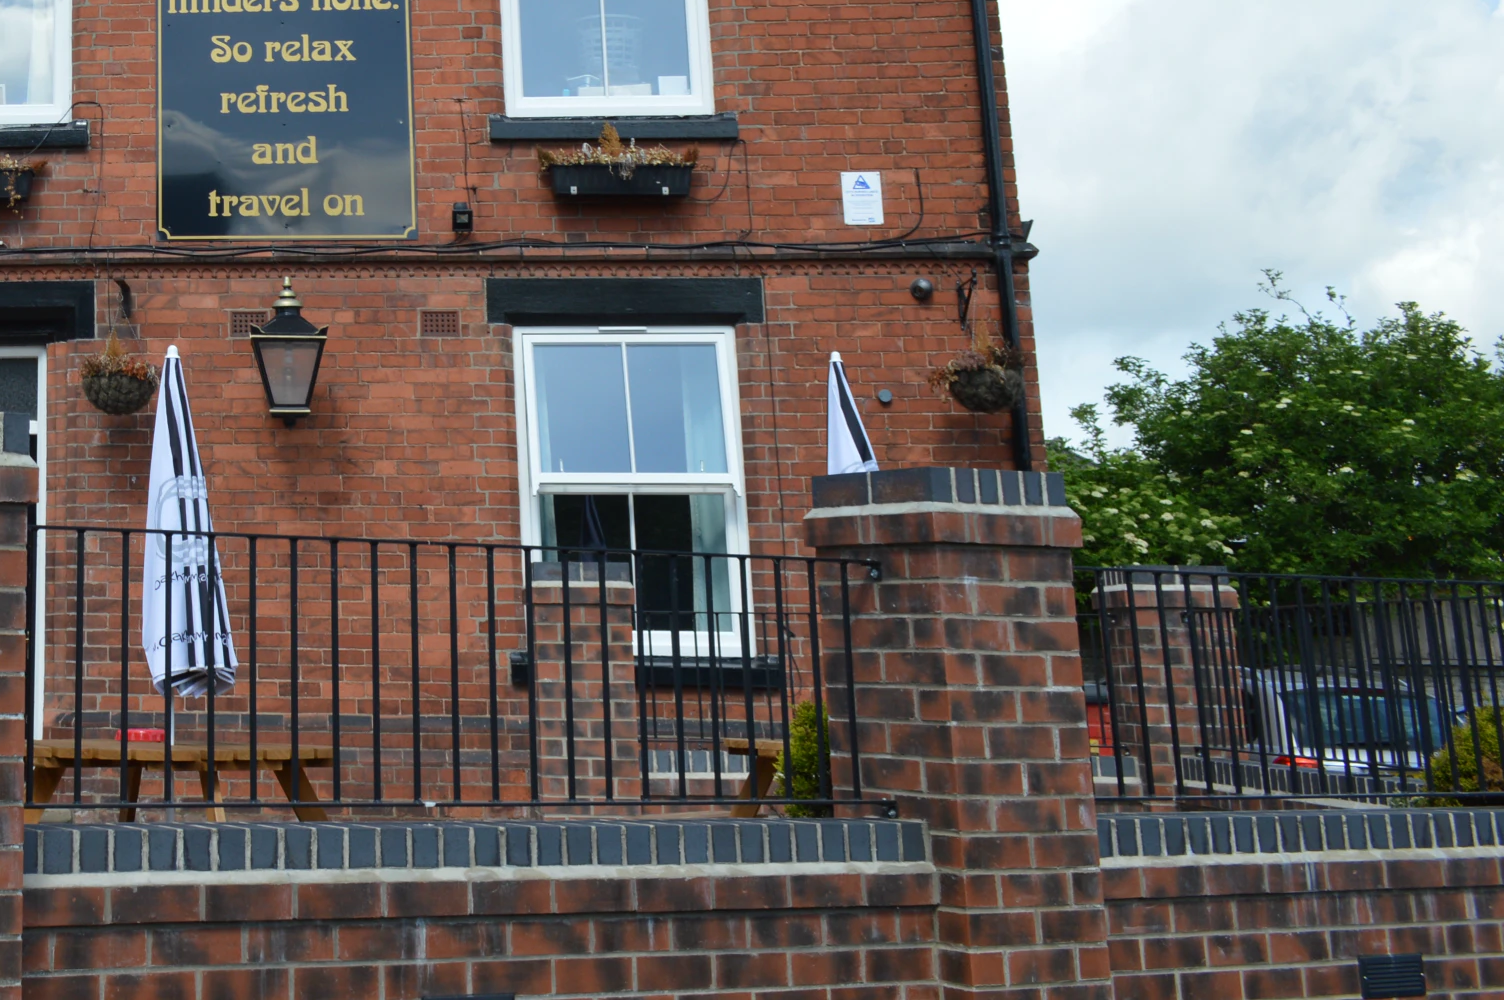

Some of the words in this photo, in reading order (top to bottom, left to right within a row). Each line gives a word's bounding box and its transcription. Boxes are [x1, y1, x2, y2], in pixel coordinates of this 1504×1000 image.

[211, 36, 252, 62] So
[266, 34, 355, 62] relax
[222, 84, 348, 113] refresh
[252, 136, 318, 164] and
[209, 187, 310, 216] travel
[324, 194, 364, 216] on
